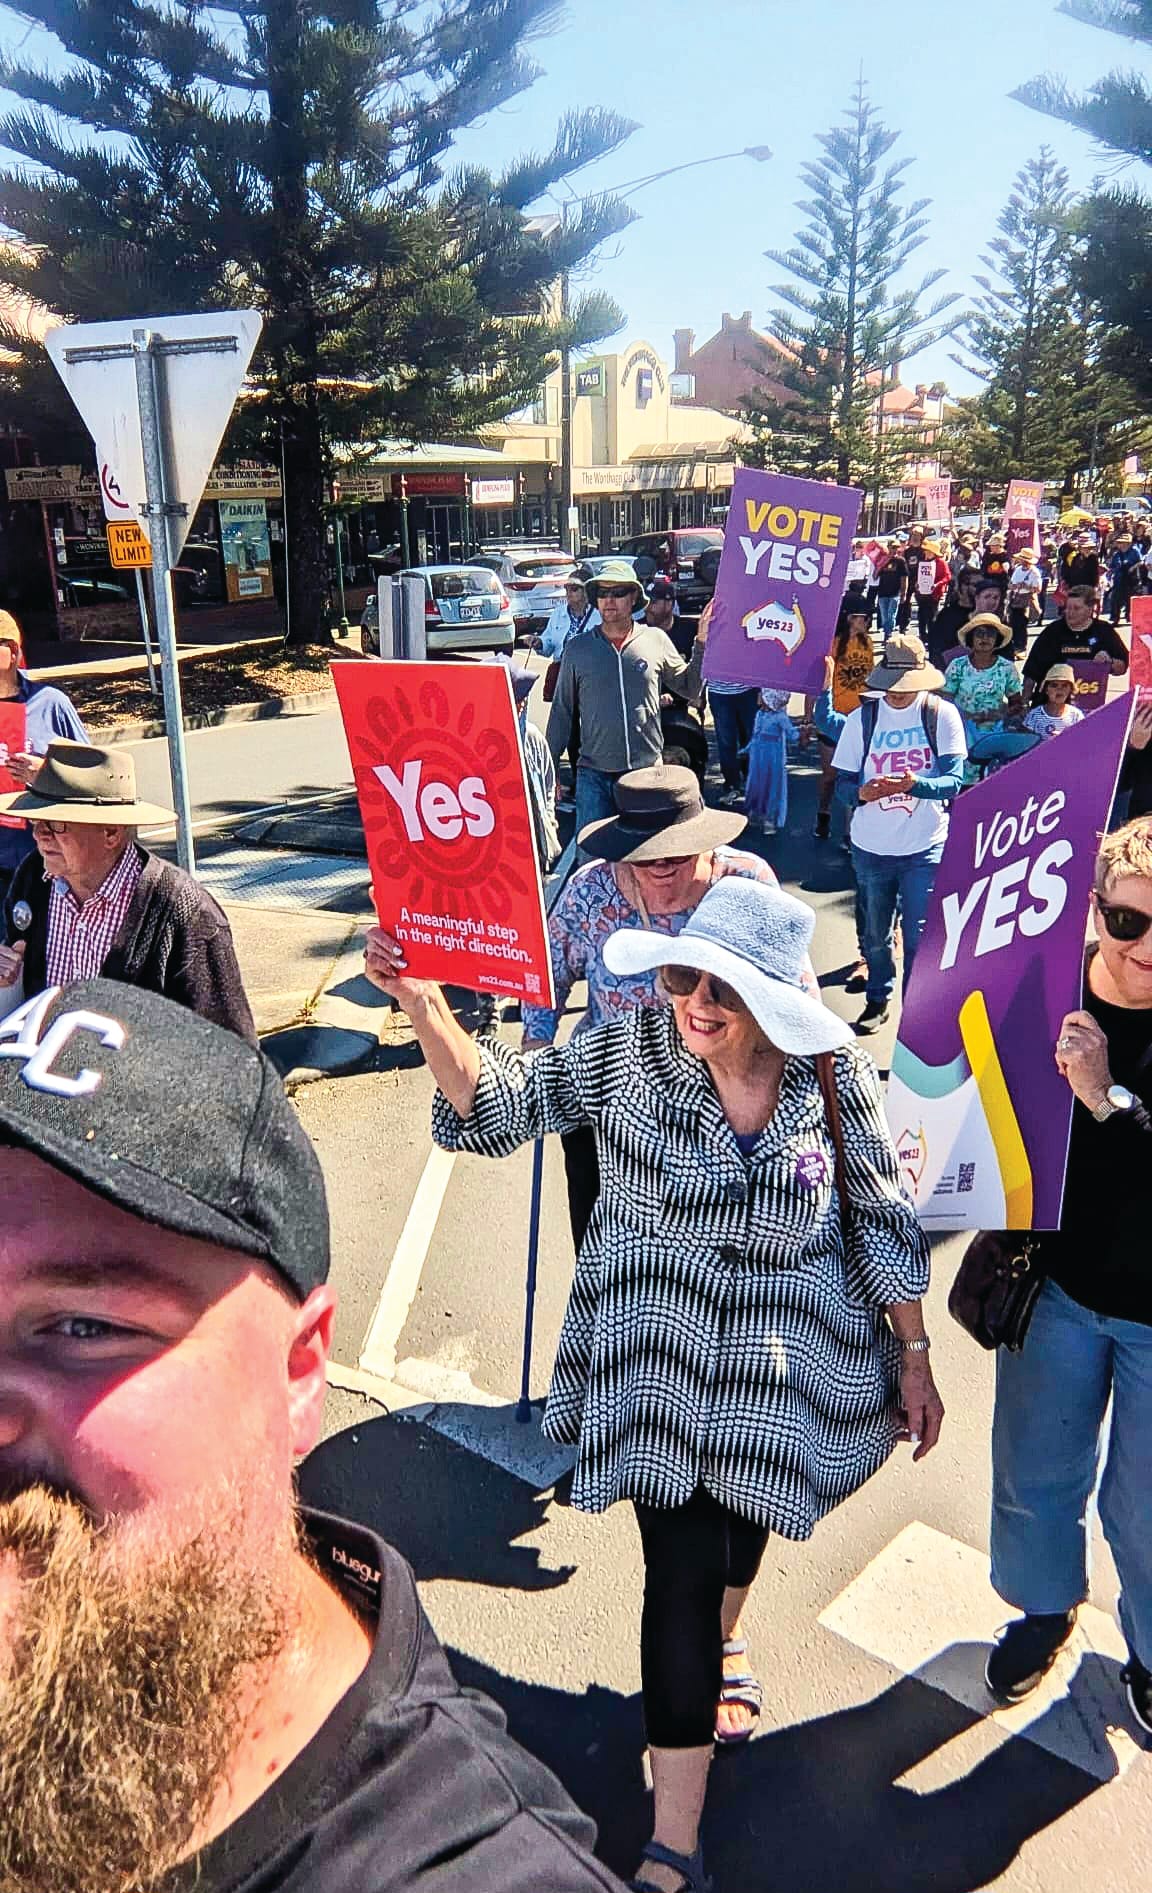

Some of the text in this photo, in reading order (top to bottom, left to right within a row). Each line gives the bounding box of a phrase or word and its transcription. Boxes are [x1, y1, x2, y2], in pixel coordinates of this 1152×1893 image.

[580, 373, 600, 385] TAB
[581, 471, 593, 485] The
[1012, 486, 1039, 497] VOTE
[229, 503, 264, 516] DAIKIN
[744, 499, 843, 547] VOTE
[1011, 527, 1031, 539] Yes
[115, 528, 141, 543] NEW
[115, 546, 148, 561] LIMIT
[738, 536, 836, 589] YES!
[756, 617, 794, 634] yes23
[872, 726, 929, 749] VOTE
[870, 747, 932, 774] YES!
[372, 759, 495, 842] Yes
[974, 790, 1066, 869] Vote
[939, 839, 1074, 971] YES
[401, 907, 519, 944] A meaningful step
[394, 925, 533, 963] in the right direction.
